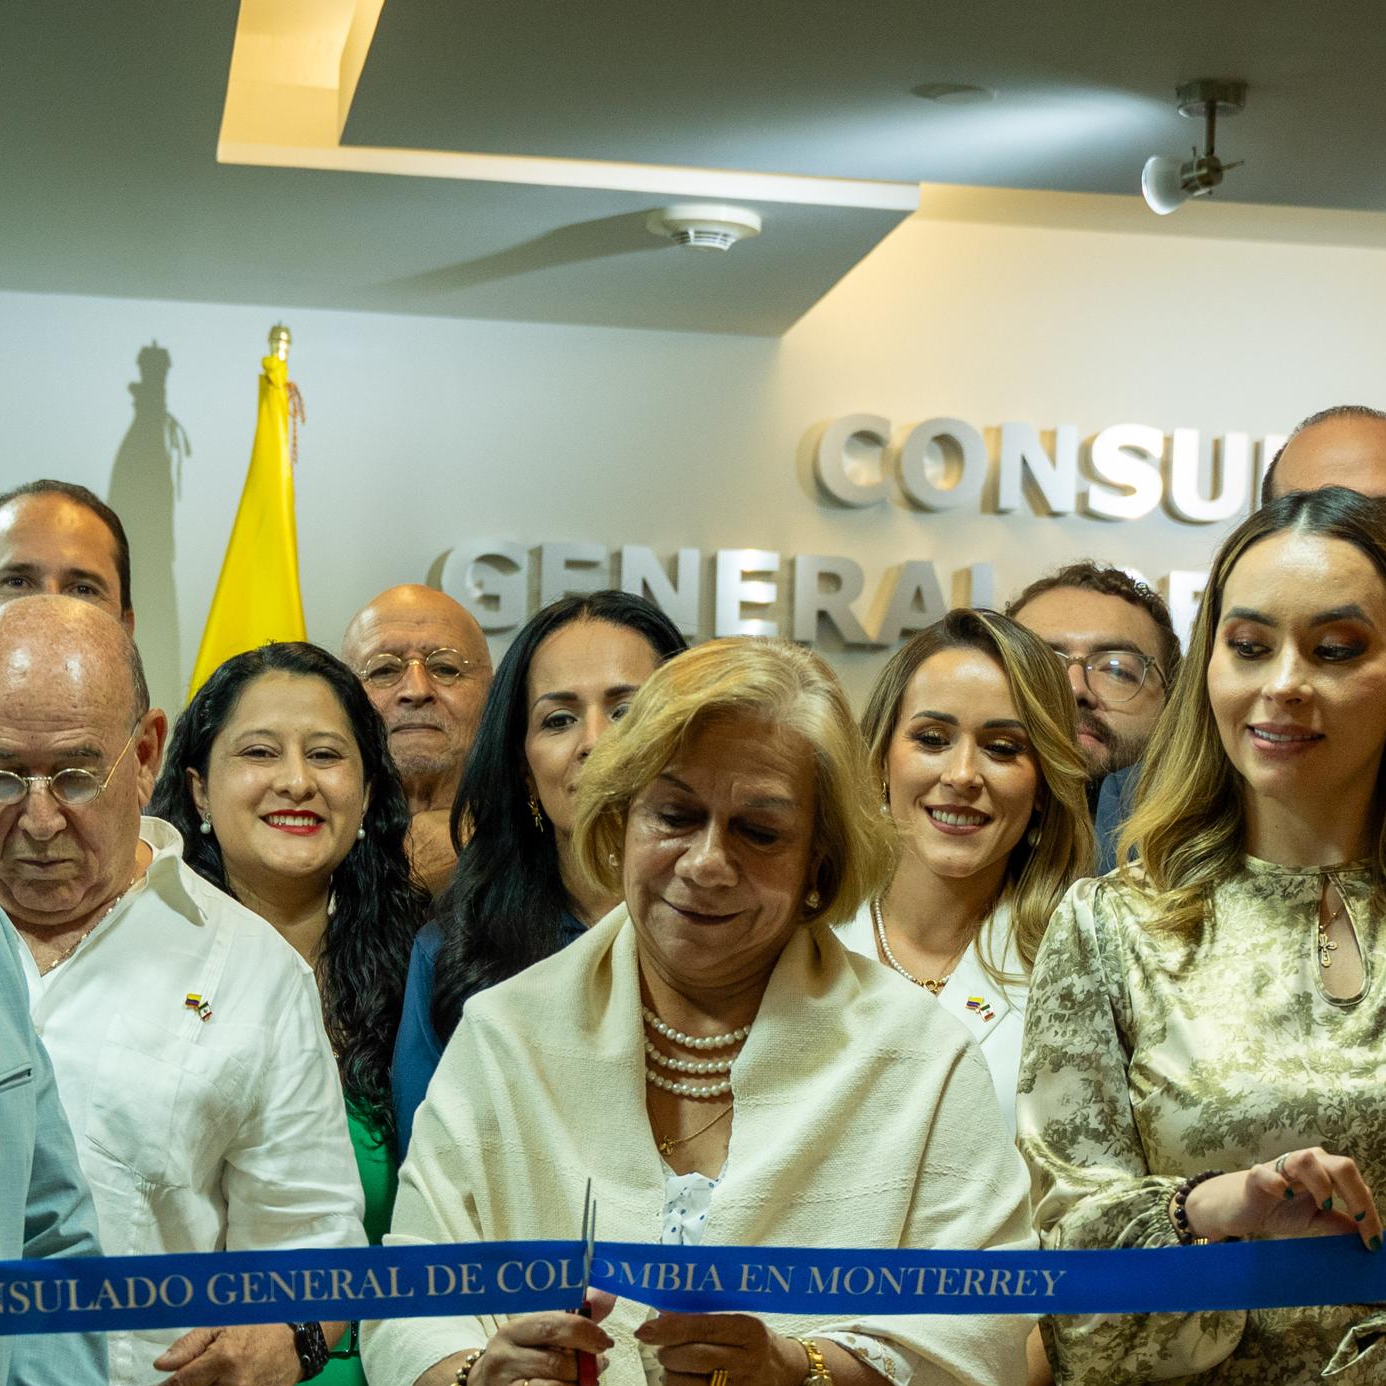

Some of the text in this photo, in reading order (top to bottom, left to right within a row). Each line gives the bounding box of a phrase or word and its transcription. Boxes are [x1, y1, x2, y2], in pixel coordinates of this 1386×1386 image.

[206, 1265, 414, 1305] GENERAL
[425, 1263, 485, 1297] DE
[738, 1263, 795, 1293] EN
[805, 1265, 1067, 1297] MONTERREY
